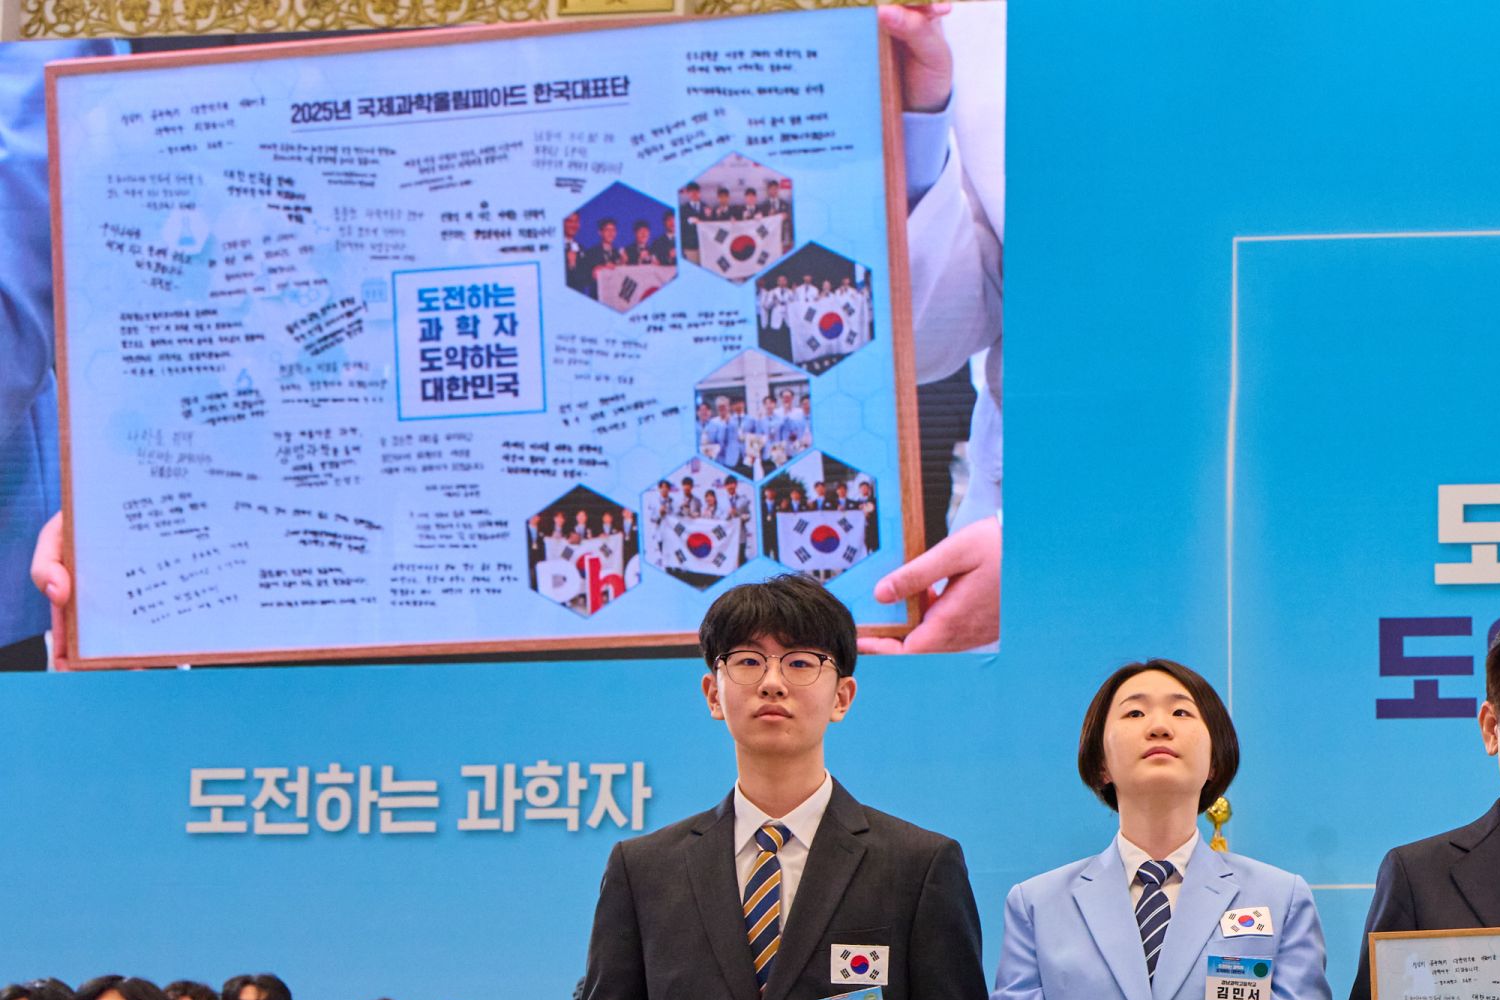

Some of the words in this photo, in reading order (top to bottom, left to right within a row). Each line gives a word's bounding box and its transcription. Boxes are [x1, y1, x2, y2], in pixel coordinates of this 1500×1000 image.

[290, 100, 352, 124] 2025년
[358, 84, 528, 119] 국제과학올림피아드
[533, 75, 630, 105] 한국대표단
[417, 282, 515, 312] 도전하는
[419, 343, 518, 373] 도약하는
[421, 372, 519, 402] 대한민국
[185, 762, 440, 835] 도전하는
[457, 760, 652, 832] 과학자
